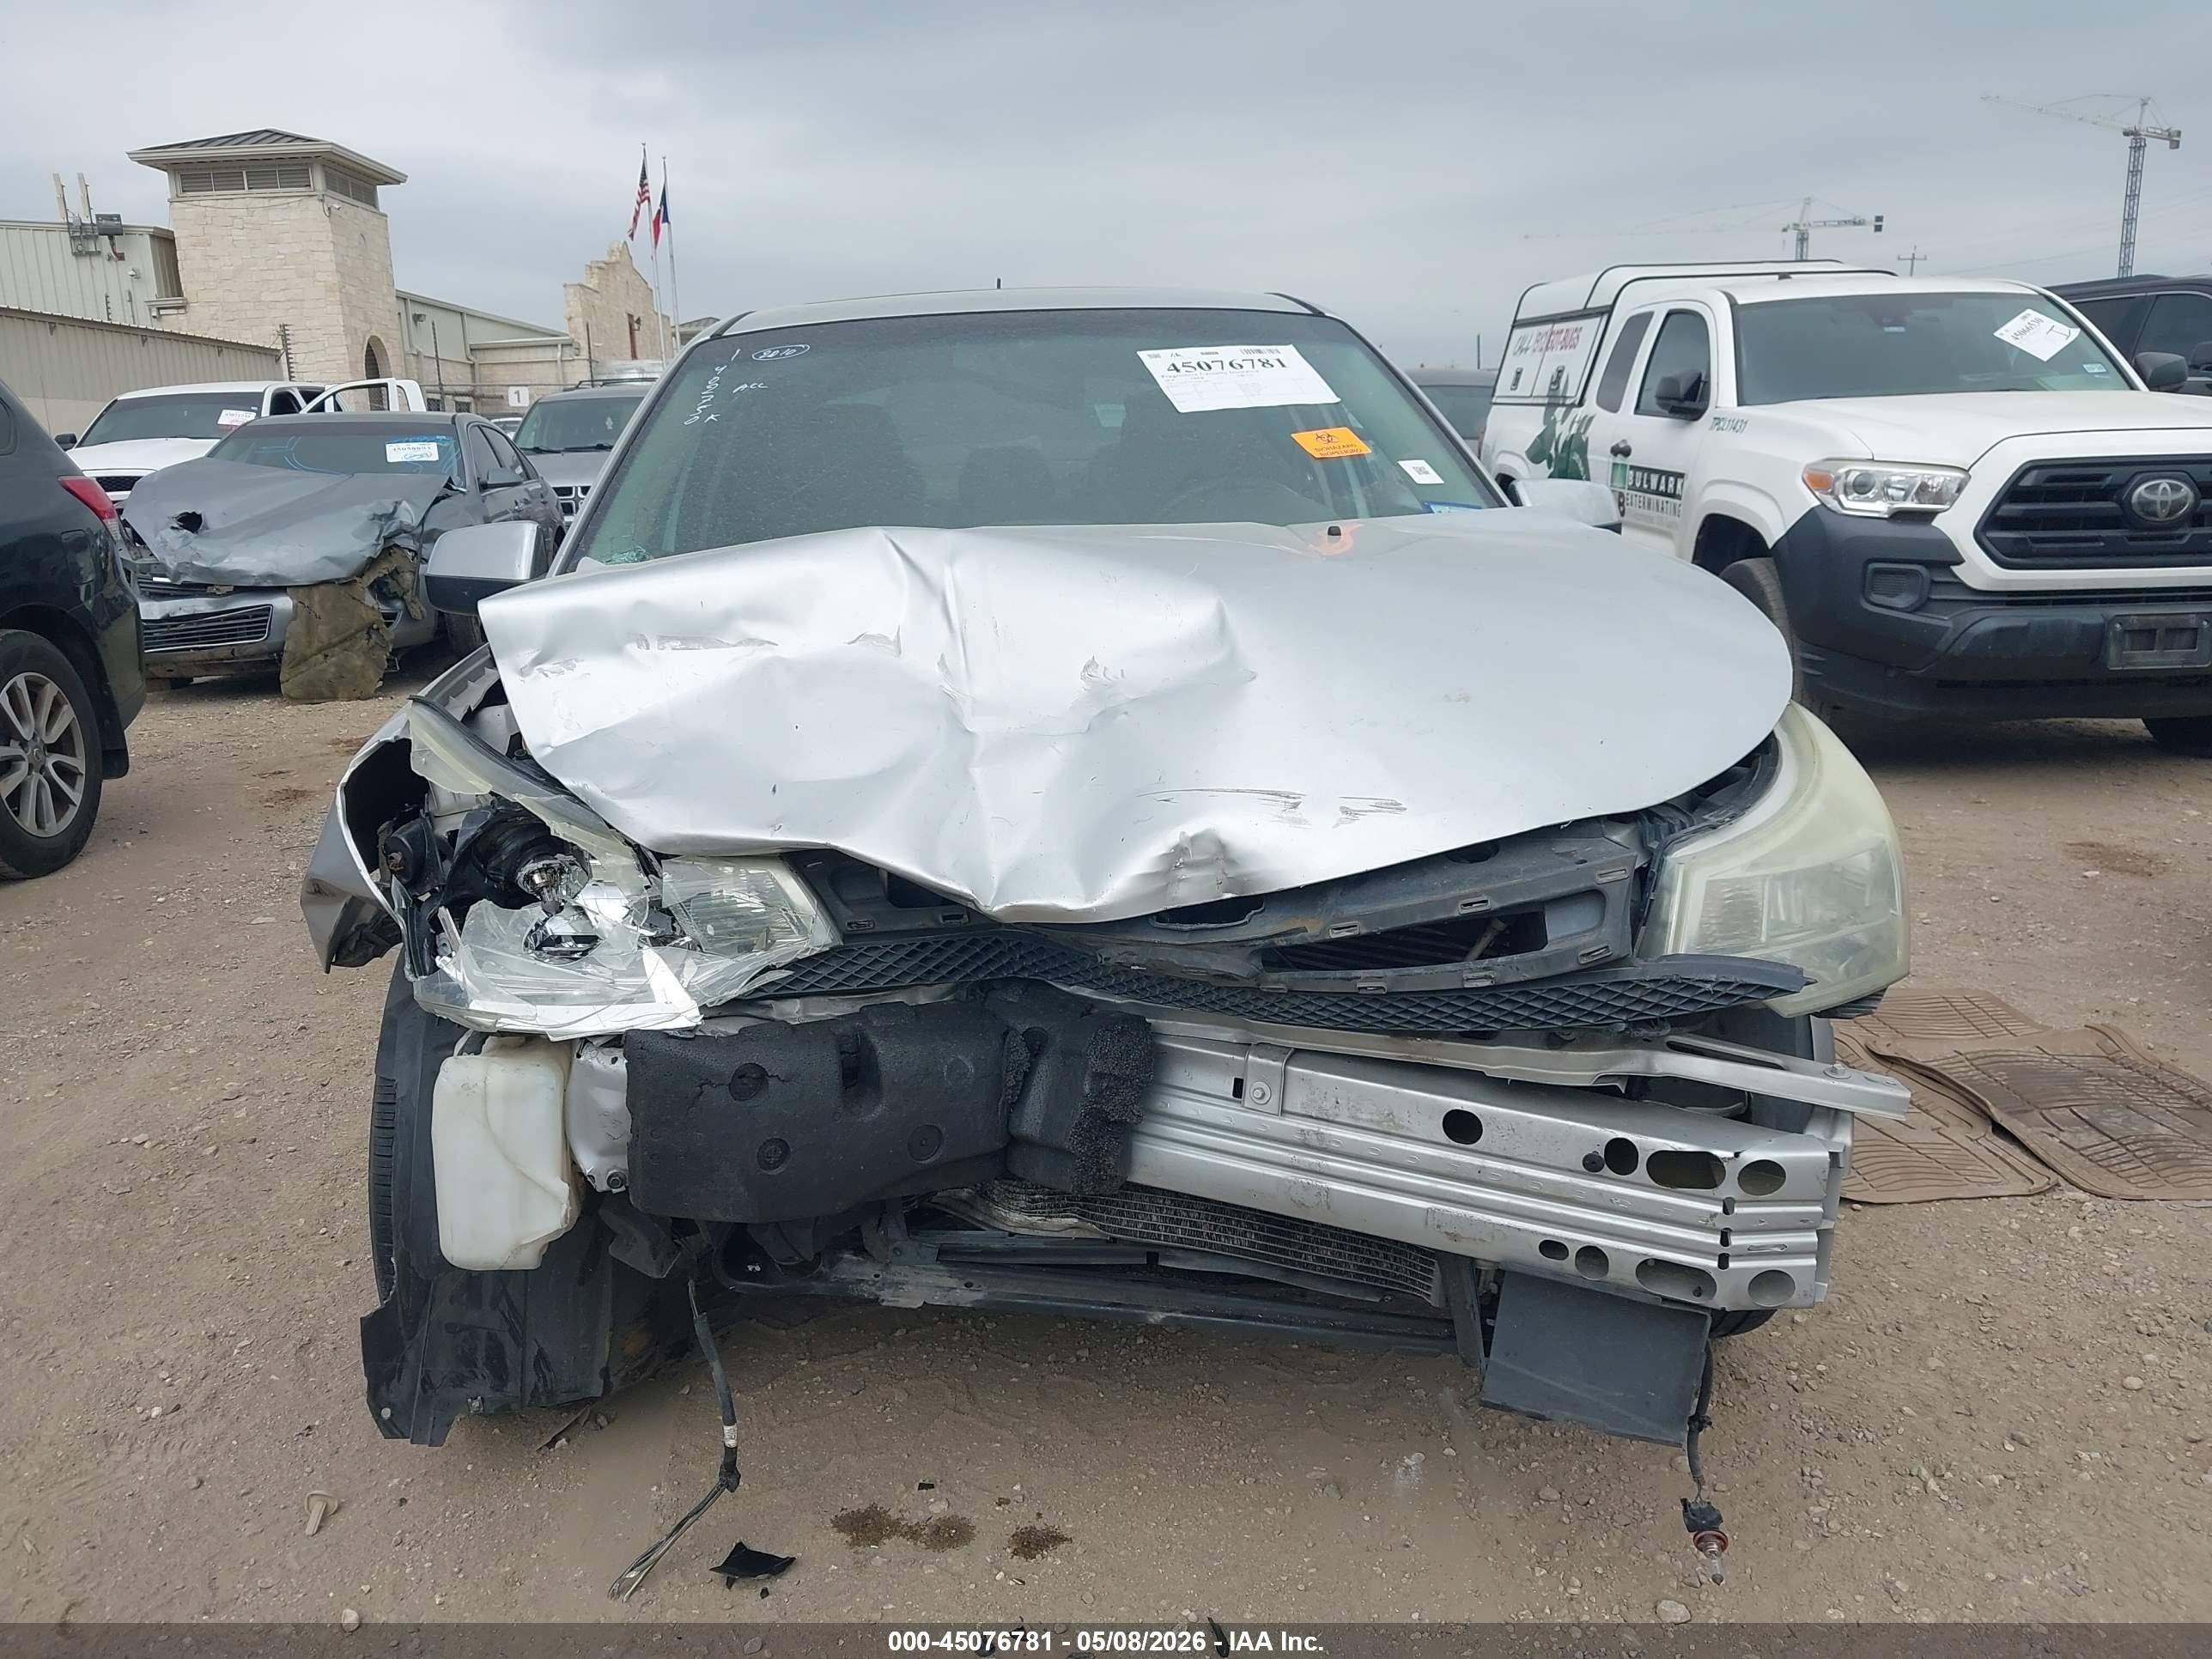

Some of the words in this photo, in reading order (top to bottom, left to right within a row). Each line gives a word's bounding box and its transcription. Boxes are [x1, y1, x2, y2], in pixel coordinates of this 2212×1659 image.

[1166, 357, 1290, 374] 45076781
[514, 389, 521, 404] 1
[1628, 470, 1684, 495] BULWARK
